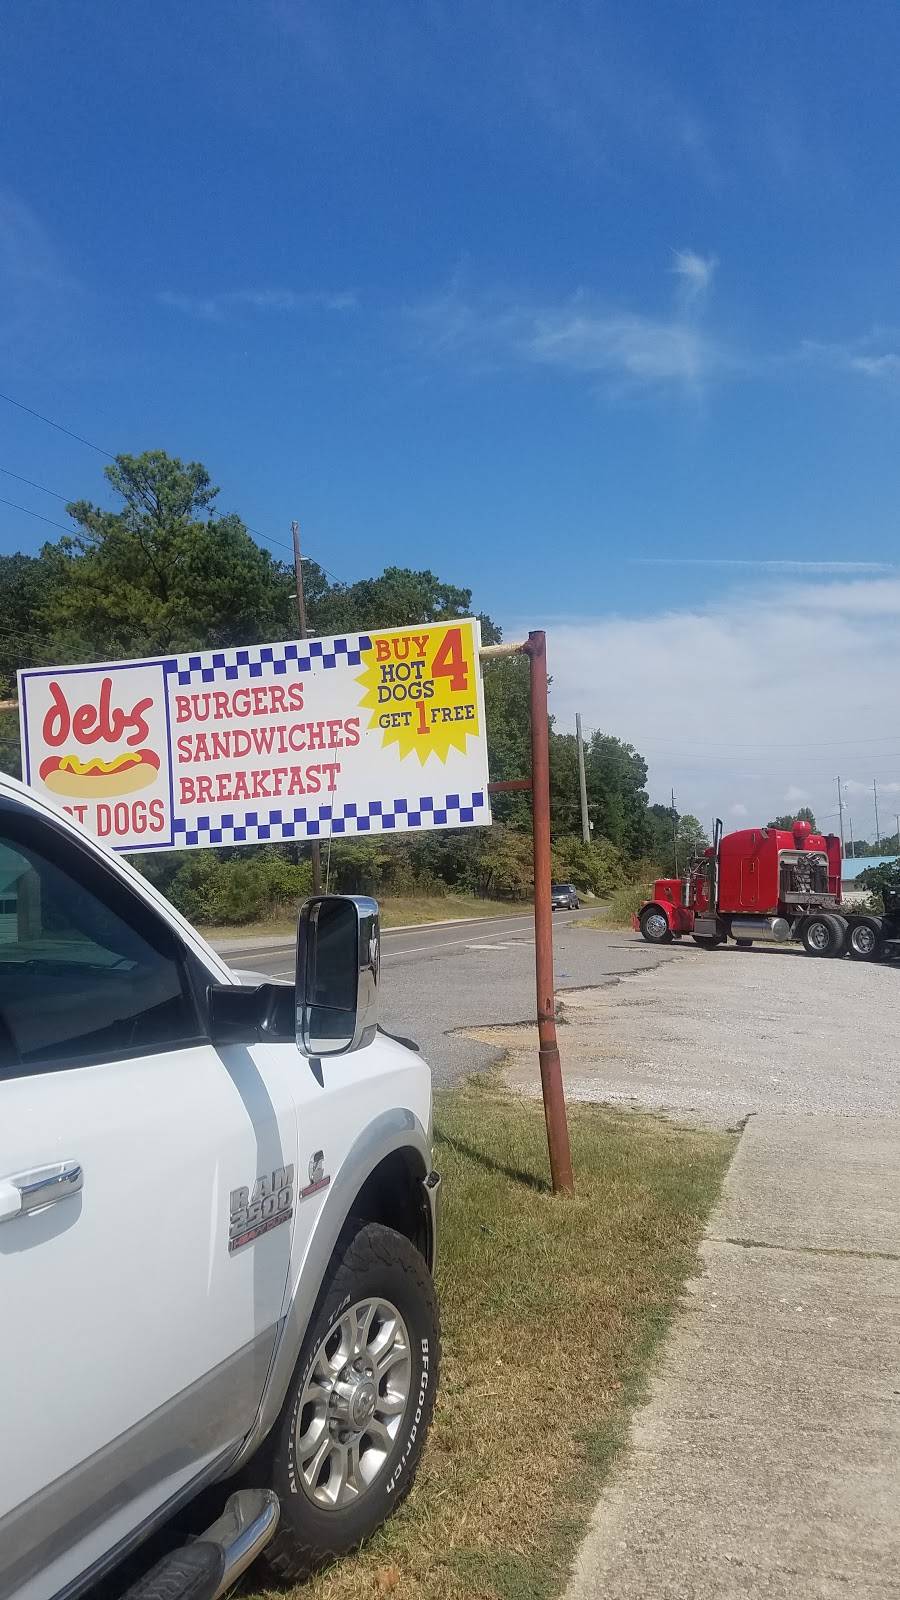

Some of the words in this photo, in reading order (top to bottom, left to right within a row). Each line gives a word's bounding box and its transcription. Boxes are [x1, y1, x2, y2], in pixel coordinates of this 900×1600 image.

[375, 635, 430, 662] BUY
[431, 628, 469, 692] 4
[379, 661, 426, 684] HOT
[42, 677, 154, 747] debs
[175, 682, 304, 723] BURGERS
[377, 680, 435, 704] DOGS
[378, 711, 413, 729] GET
[415, 700, 431, 735] 1
[430, 704, 475, 724] FREE
[177, 717, 361, 764] SANDWICHES
[179, 762, 341, 805] BREAKFAST
[97, 799, 165, 836] DOGS
[229, 1163, 294, 1212] RAM
